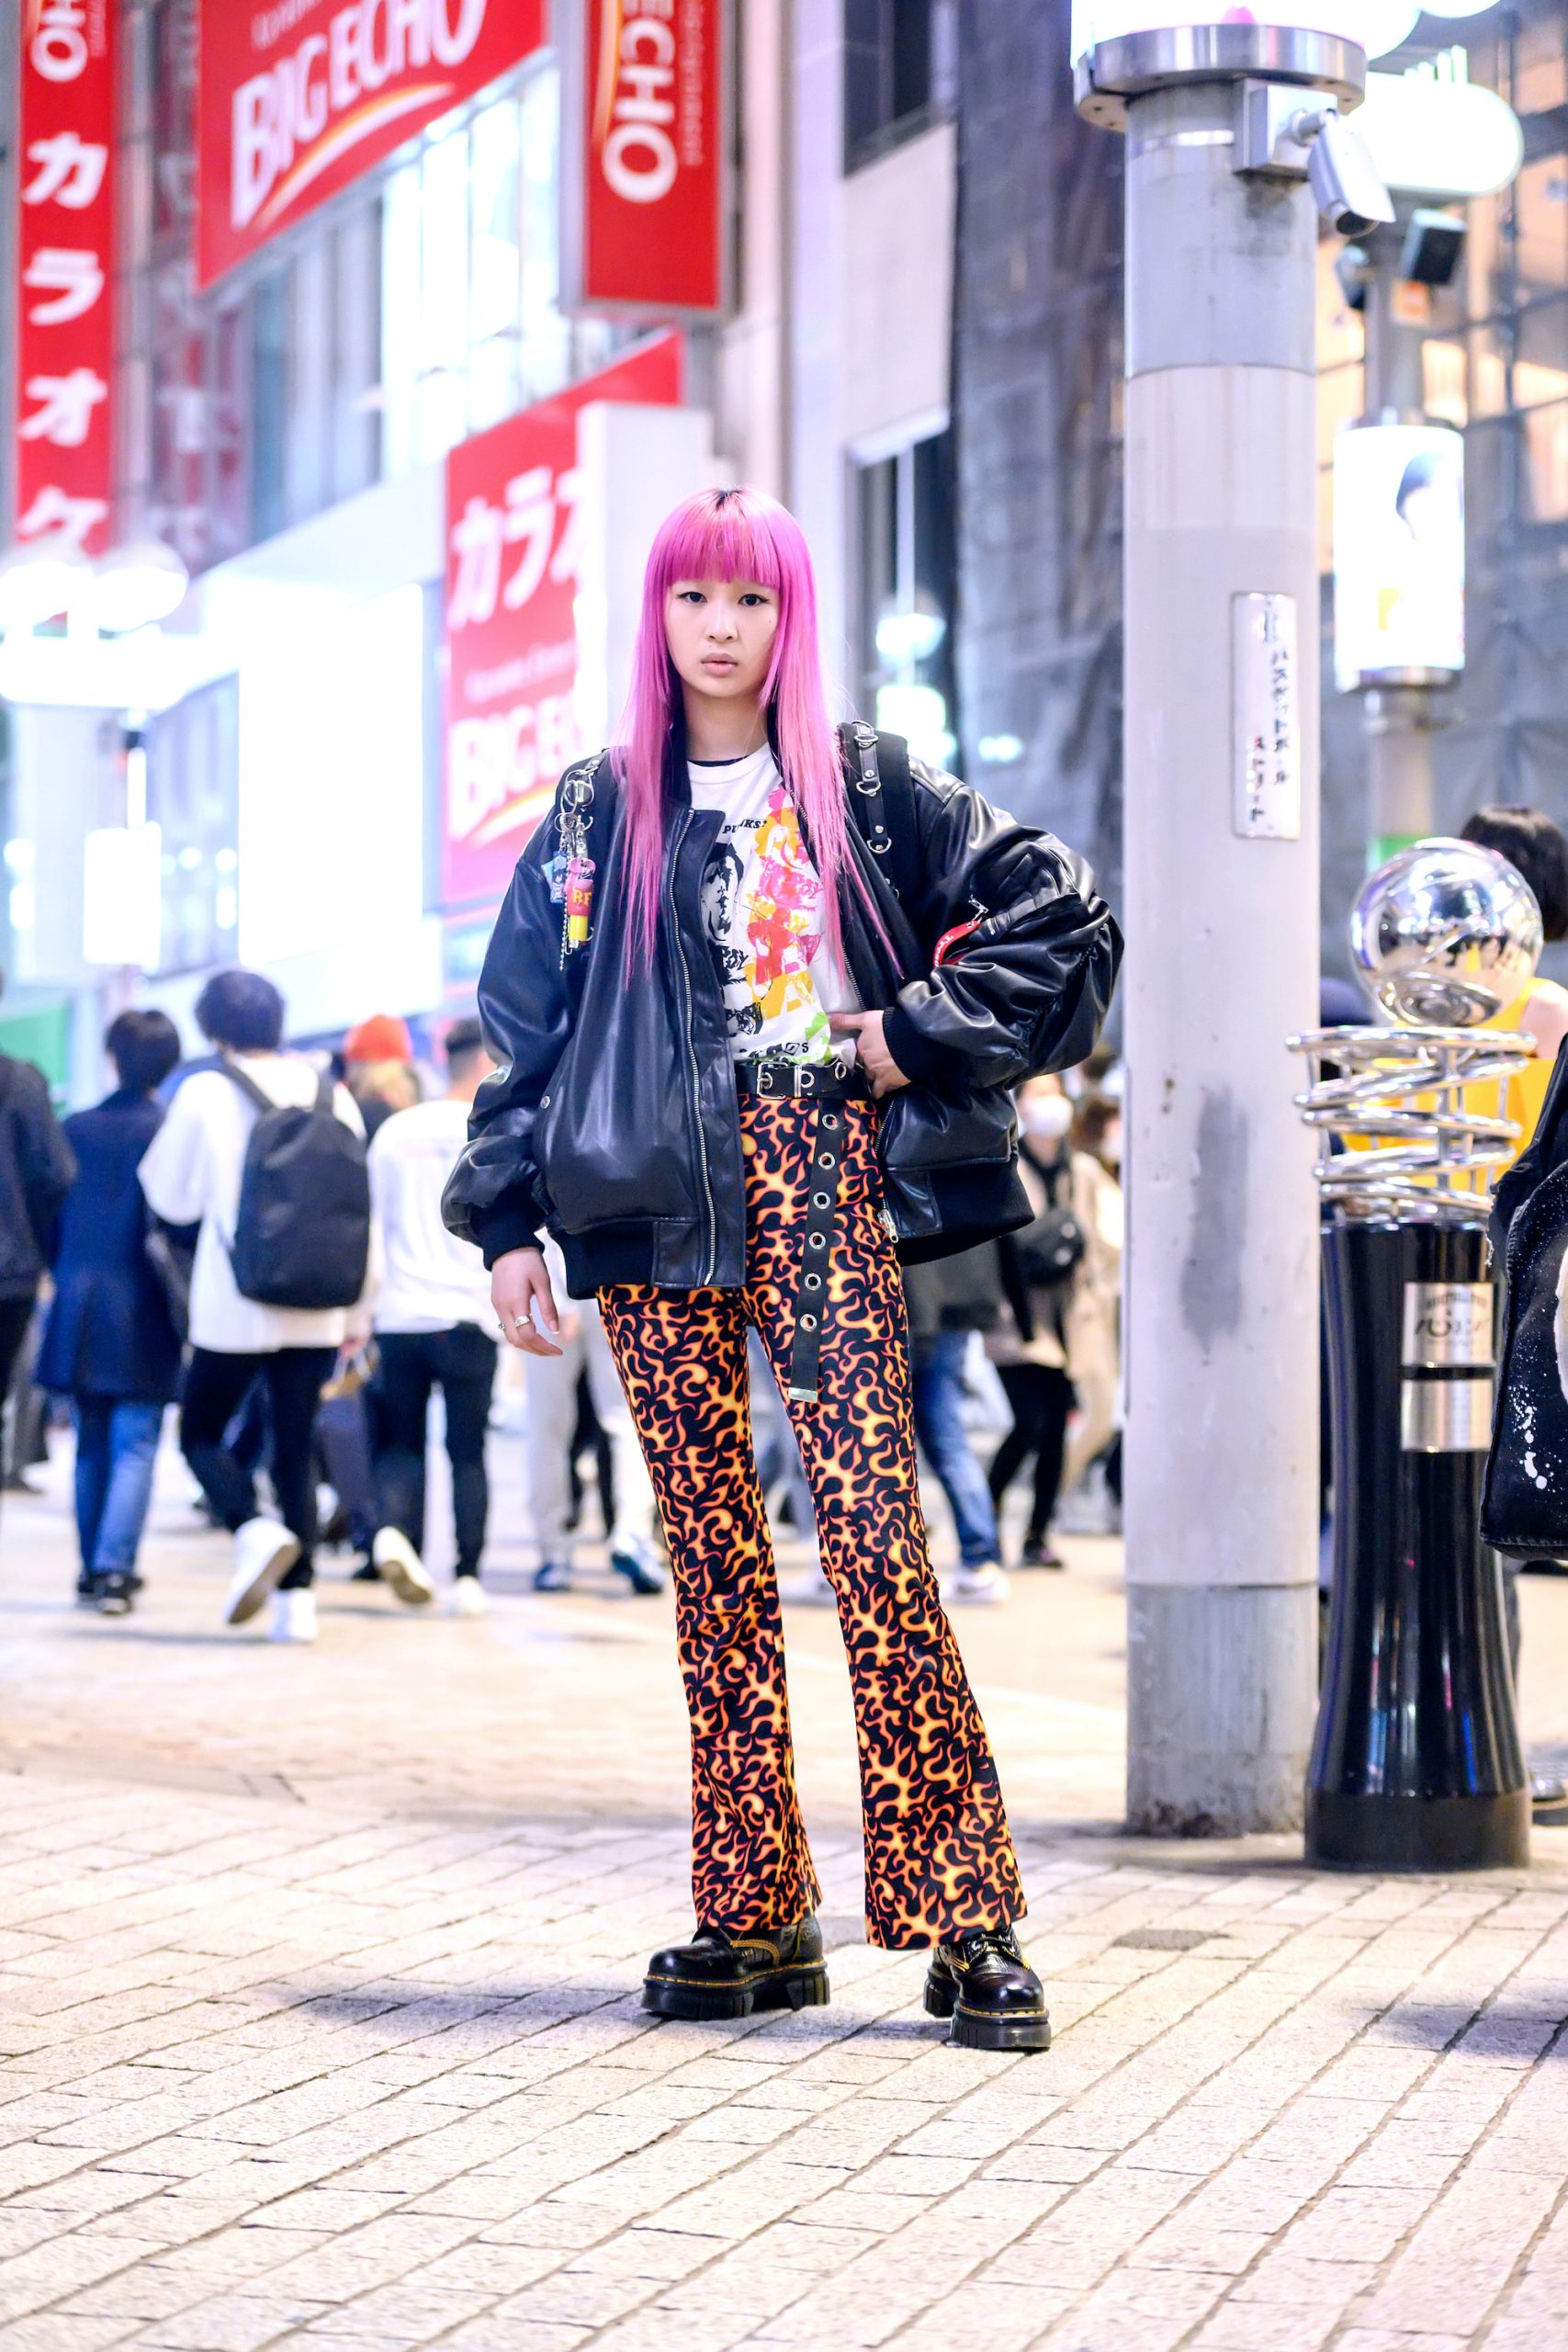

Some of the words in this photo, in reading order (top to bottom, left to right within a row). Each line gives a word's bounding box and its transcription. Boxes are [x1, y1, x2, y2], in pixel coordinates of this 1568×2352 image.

[231, 33, 328, 230] BIG
[331, 0, 485, 108] ECHO
[17, 130, 108, 549] カラオケ
